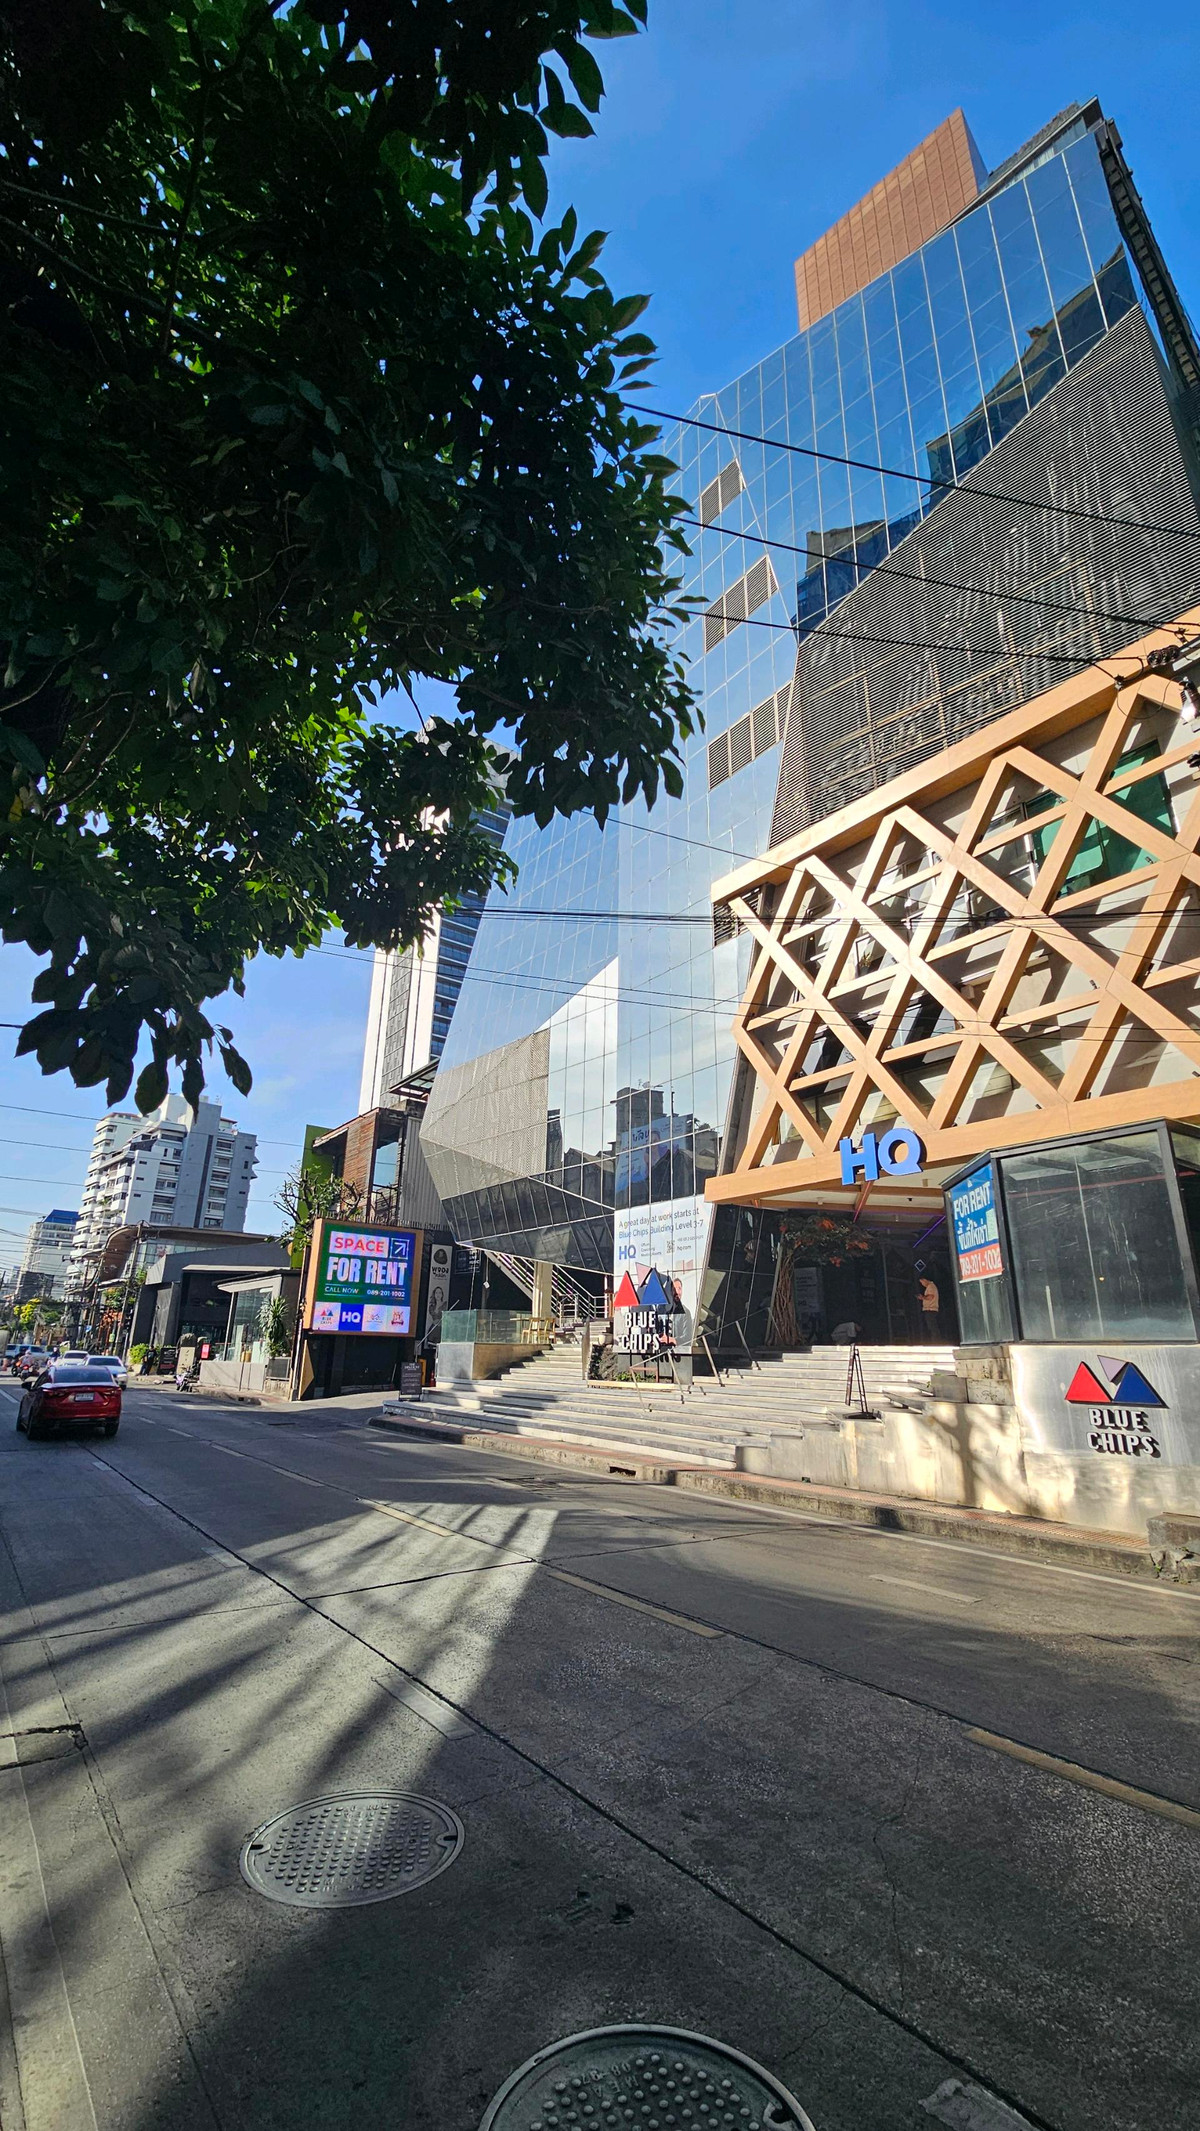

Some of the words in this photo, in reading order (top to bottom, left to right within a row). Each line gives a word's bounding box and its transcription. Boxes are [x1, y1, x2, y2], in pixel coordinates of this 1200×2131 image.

[839, 1128, 923, 1185] HQ
[953, 1196, 970, 1220] FOR
[969, 1181, 991, 1213] RENT
[624, 1218, 639, 1229] great
[640, 1217, 650, 1226] day
[651, 1215, 657, 1223] at
[658, 1212, 673, 1221] work
[674, 1208, 691, 1219] starts
[693, 1207, 700, 1215] at
[619, 1231, 631, 1239] Blue
[633, 1227, 649, 1238] Chips
[650, 1223, 674, 1235] Building
[675, 1221, 692, 1231] Level
[693, 1219, 704, 1229] 3-7
[334, 1237, 385, 1253] SPACE
[618, 1244, 637, 1261] HQ
[326, 1256, 361, 1283] FOR
[365, 1259, 408, 1286] RENT
[341, 1311, 361, 1323] HQ
[625, 1311, 656, 1328] BLUE
[621, 1333, 661, 1351] CHIPS
[1088, 1408, 1144, 1429] BLUE
[1086, 1432, 1155, 1455] CHIPS
